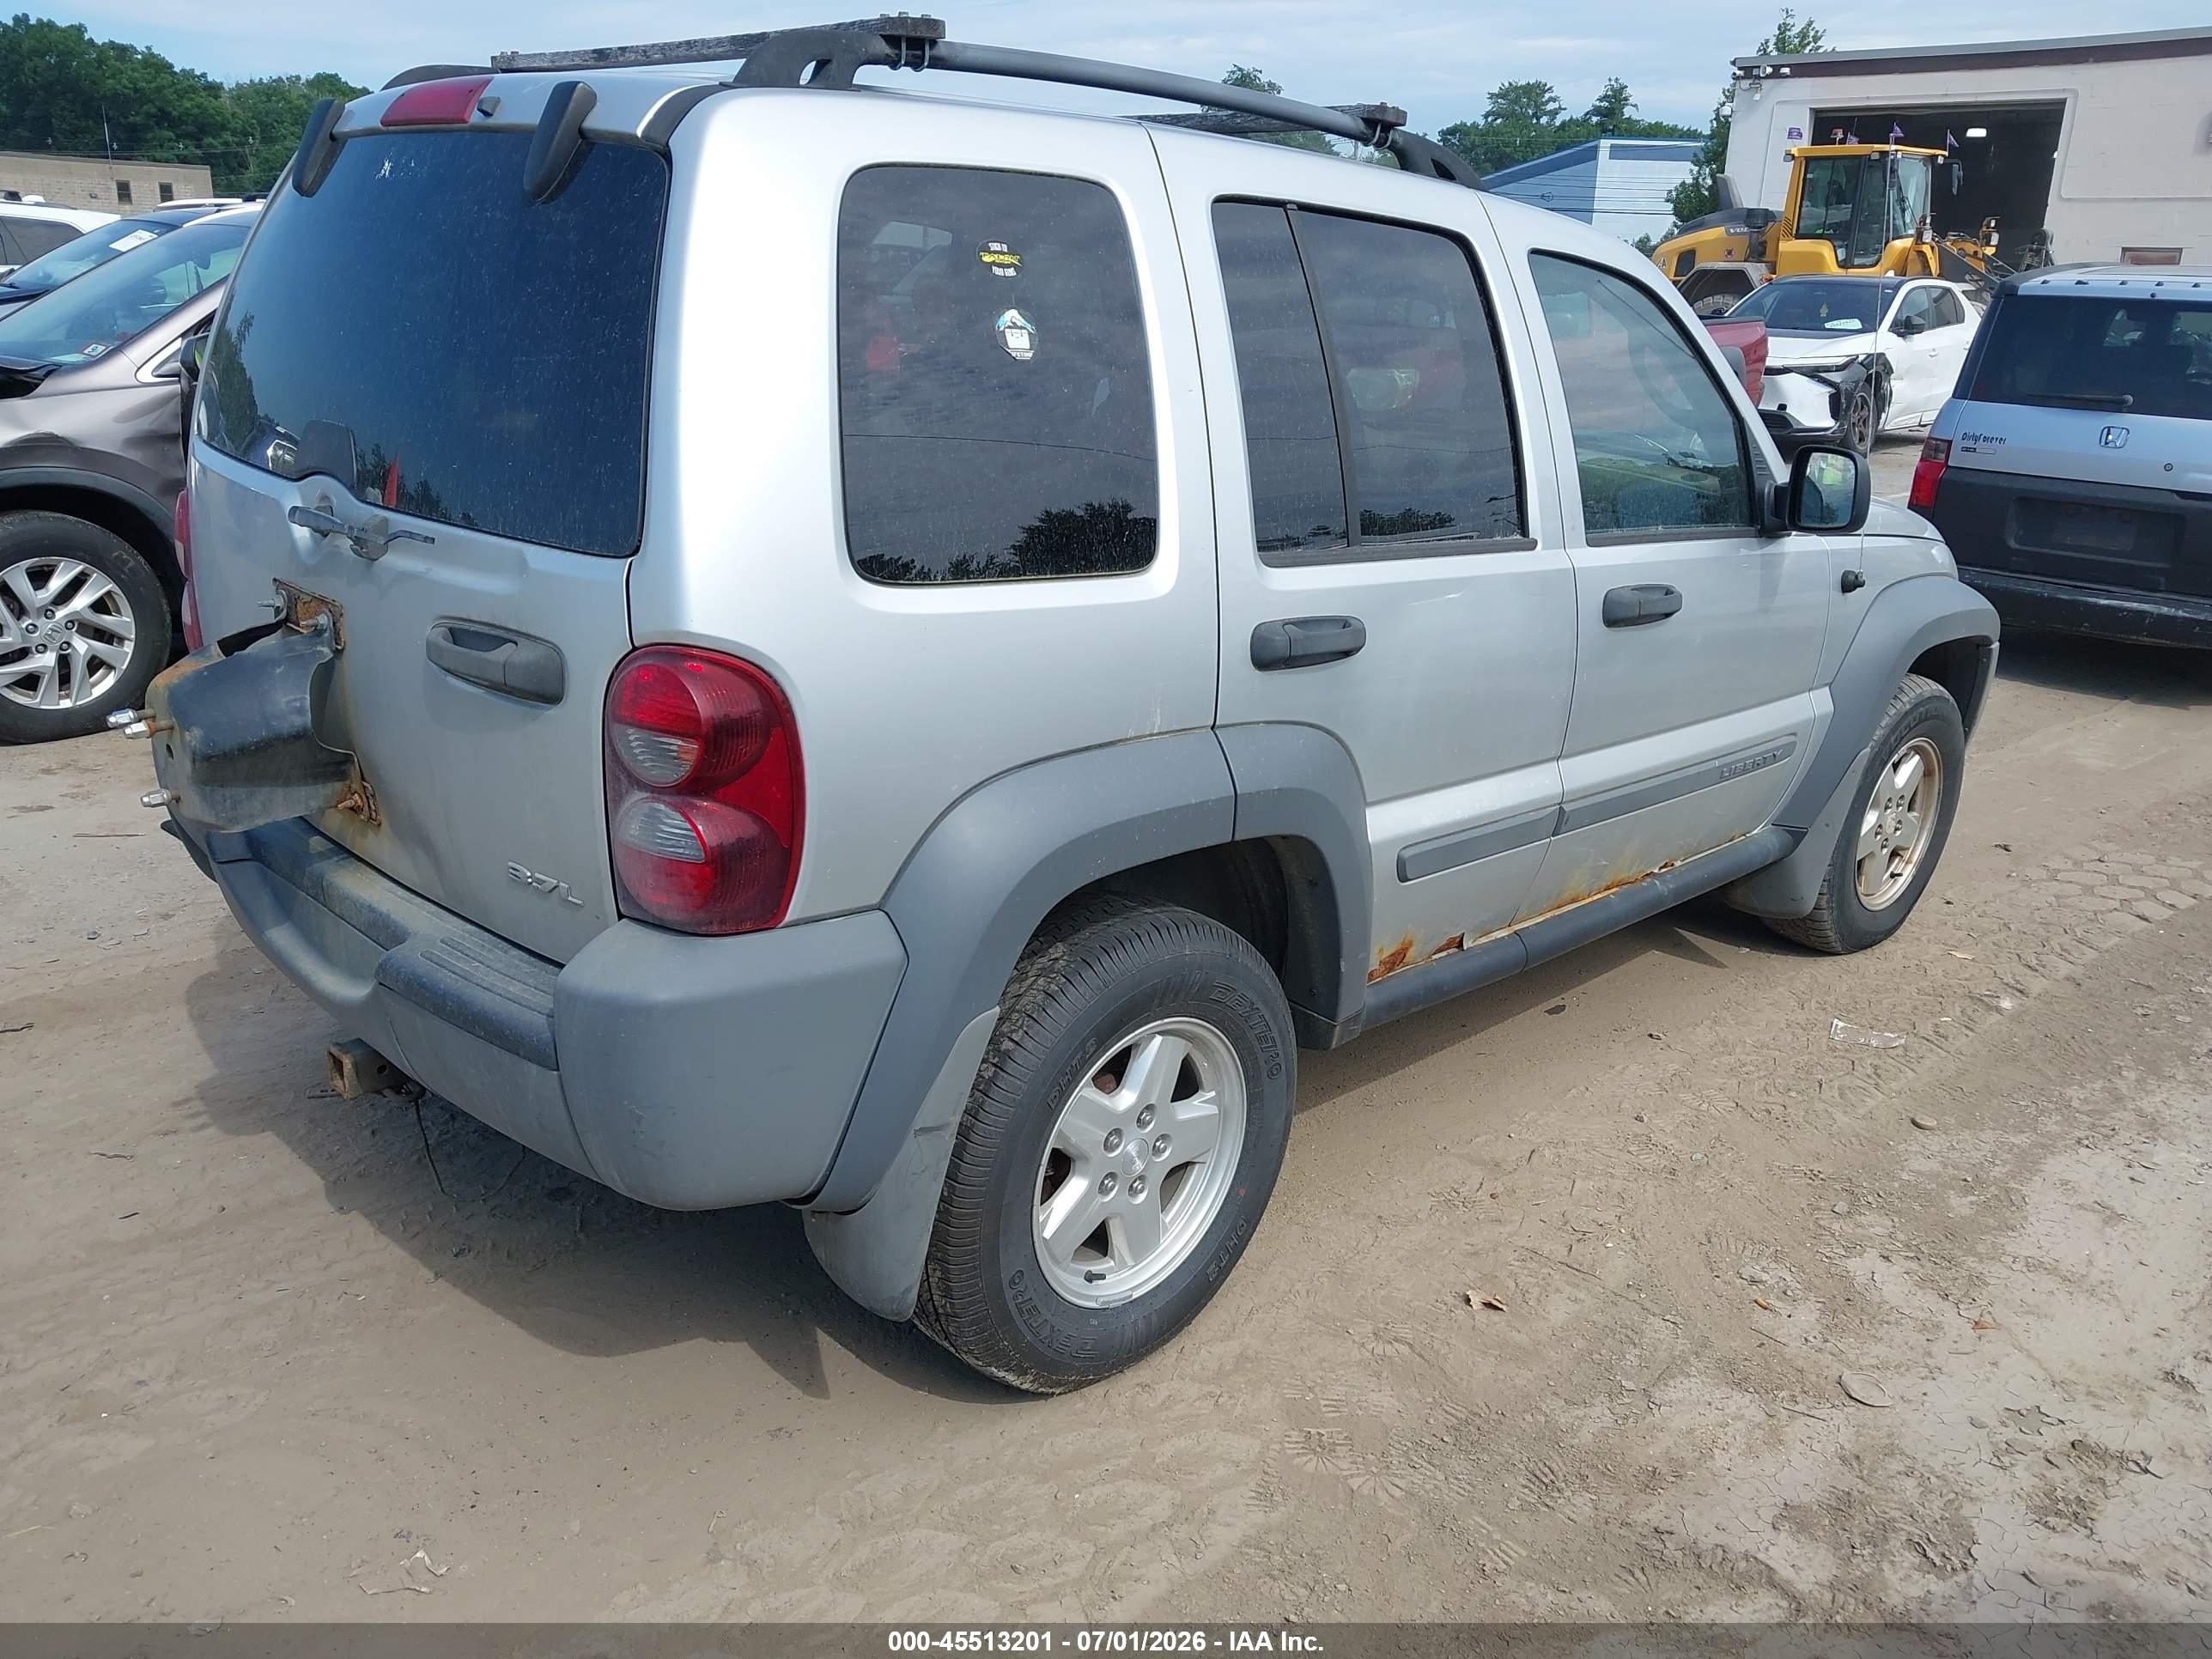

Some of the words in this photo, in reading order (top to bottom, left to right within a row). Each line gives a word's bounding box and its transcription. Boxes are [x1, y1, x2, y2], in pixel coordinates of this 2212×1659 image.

[1720, 748, 1784, 780] LIBERTY
[507, 860, 584, 907] 3.7L
[1209, 980, 1283, 1080] DEXTERO
[1008, 1269, 1100, 1358] DEXTERO
